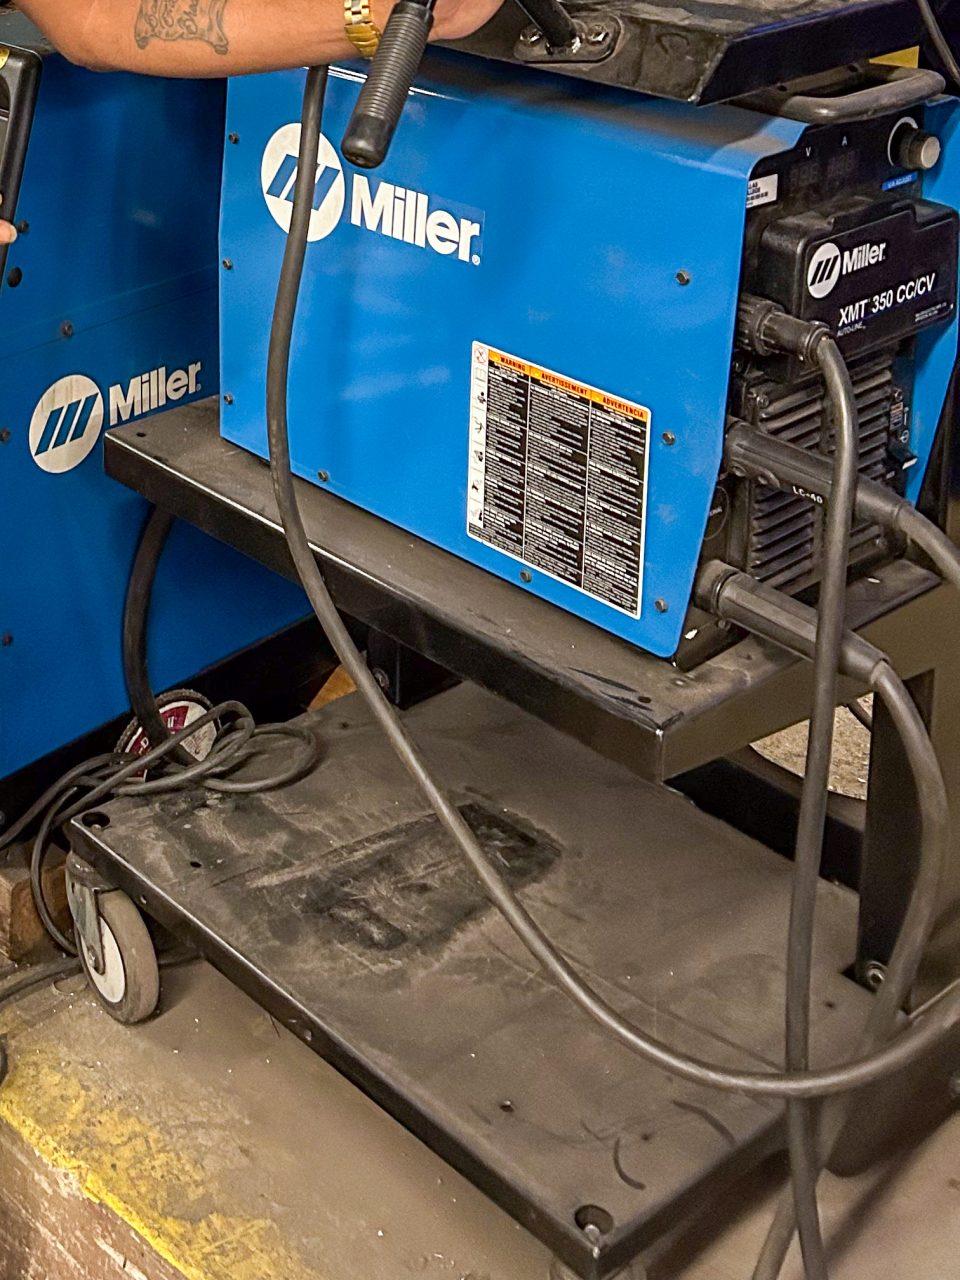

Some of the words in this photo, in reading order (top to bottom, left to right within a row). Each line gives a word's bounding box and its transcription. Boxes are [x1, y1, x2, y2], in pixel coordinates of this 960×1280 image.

[351, 173, 481, 265] Miller
[842, 242, 887, 275] Miller
[838, 299, 868, 327] XMT
[871, 289, 894, 314] 350
[896, 272, 936, 303] CC/CV
[500, 356, 526, 372] WARNING
[109, 361, 202, 426] Miller
[541, 372, 588, 395] AVERTISSEMENT
[602, 397, 644, 419] ADVERTENCIA
[792, 485, 823, 504] LC-40
